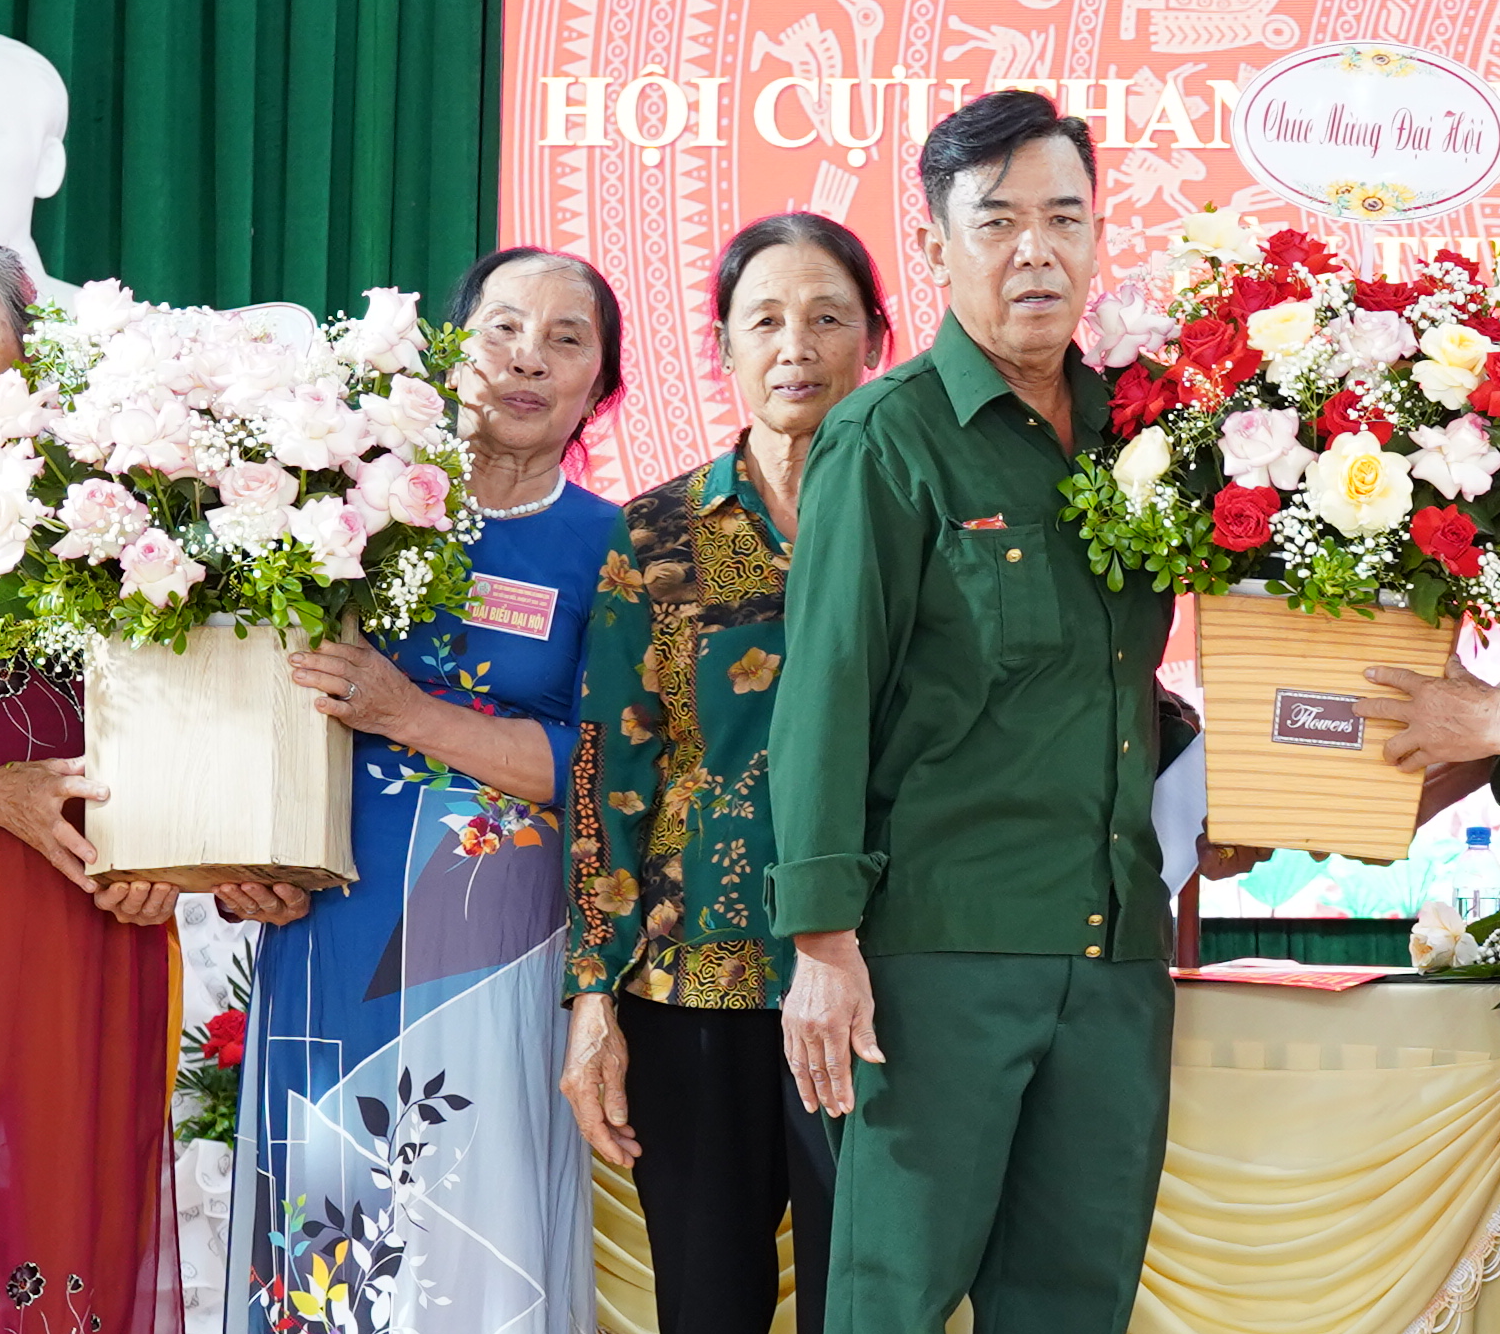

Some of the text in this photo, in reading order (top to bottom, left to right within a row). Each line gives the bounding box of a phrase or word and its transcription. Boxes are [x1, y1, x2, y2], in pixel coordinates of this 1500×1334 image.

[538, 63, 727, 167] HỘI
[1263, 98, 1484, 163] Chúc Mừng Đại Hội
[1286, 702, 1354, 733] Flowers
